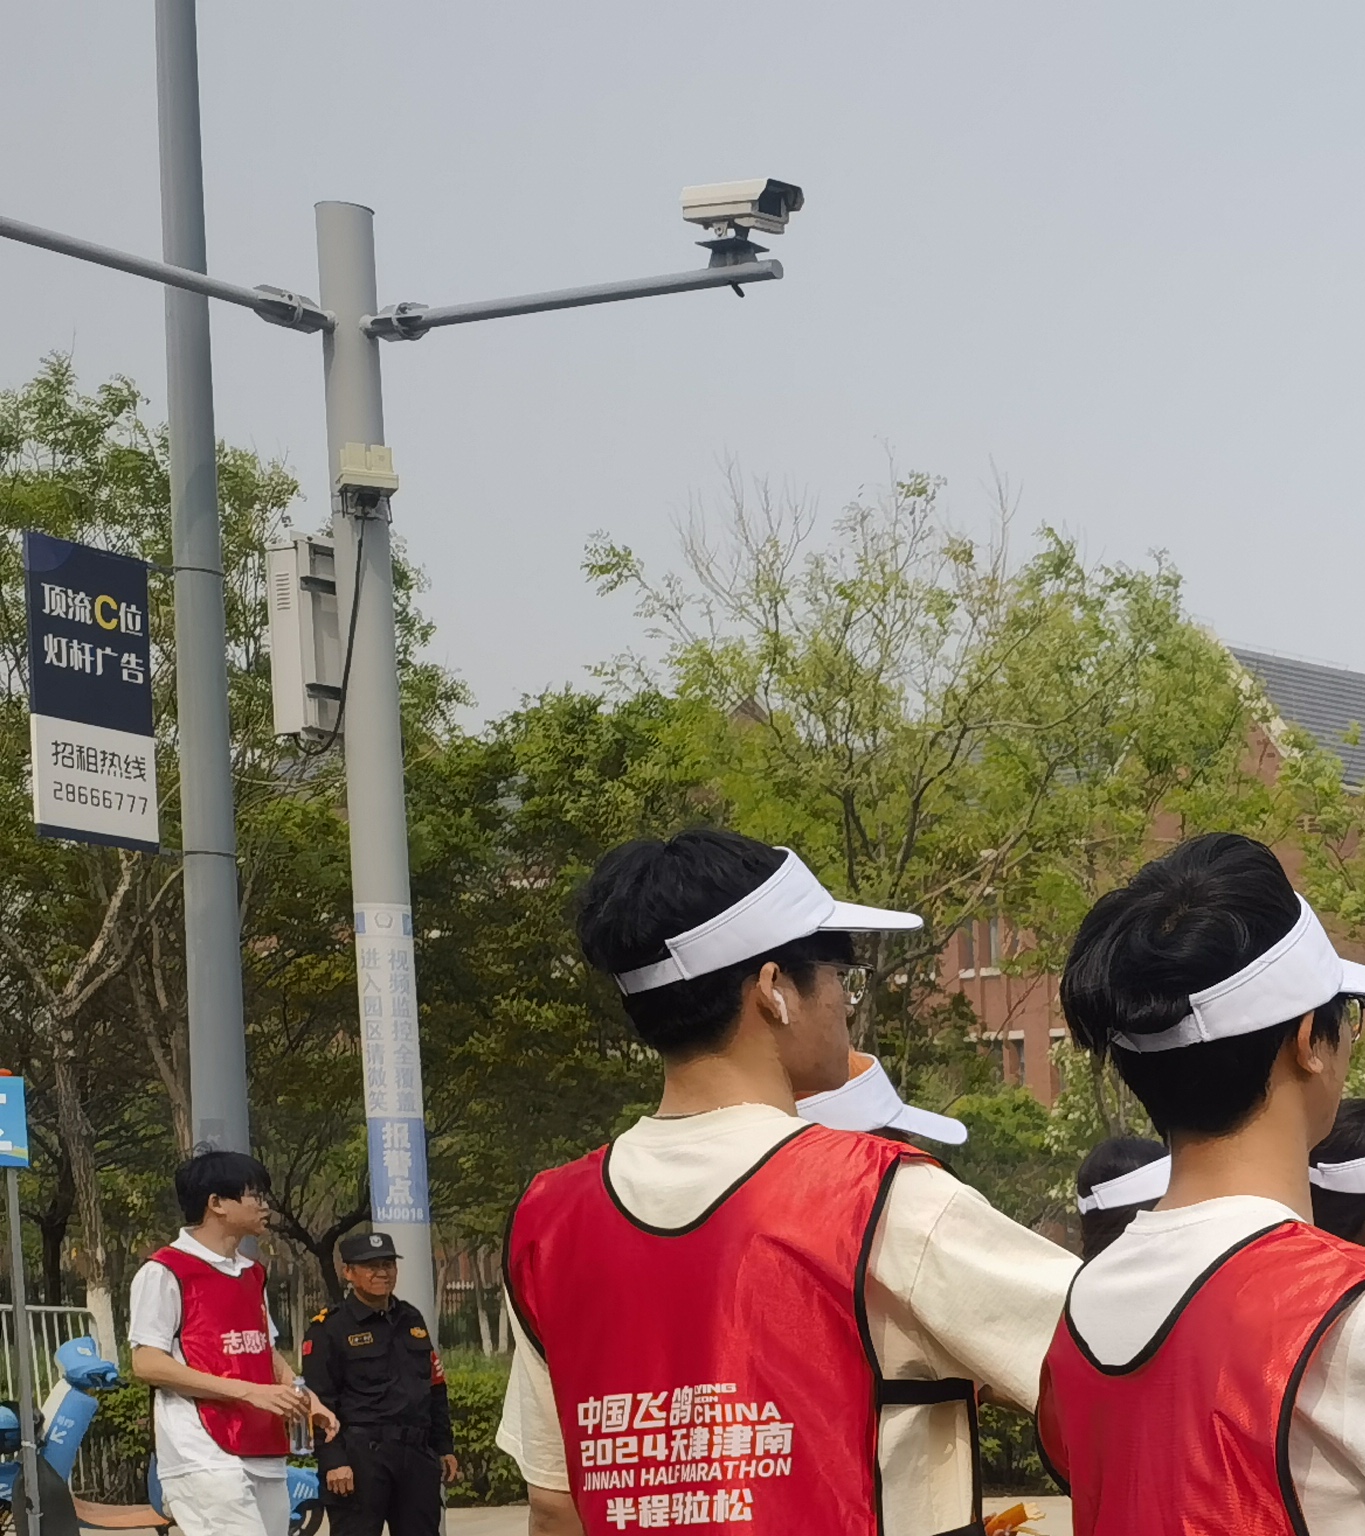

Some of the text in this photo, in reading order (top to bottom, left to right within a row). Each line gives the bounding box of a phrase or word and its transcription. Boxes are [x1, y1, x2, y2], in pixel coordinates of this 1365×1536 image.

[41, 582, 144, 638] 顶流C位
[43, 632, 146, 685] 灯杆广告
[51, 739, 148, 783] 招租热线
[53, 780, 149, 815] 28666777
[361, 947, 388, 1113] 进入园区请微笑
[388, 947, 418, 1113] 视频监控全覆盖
[381, 1121, 414, 1205] 报警点
[577, 1386, 693, 1435] 中国飞鸽
[694, 1402, 782, 1424] CHINA
[583, 1469, 634, 1492] JINNAN
